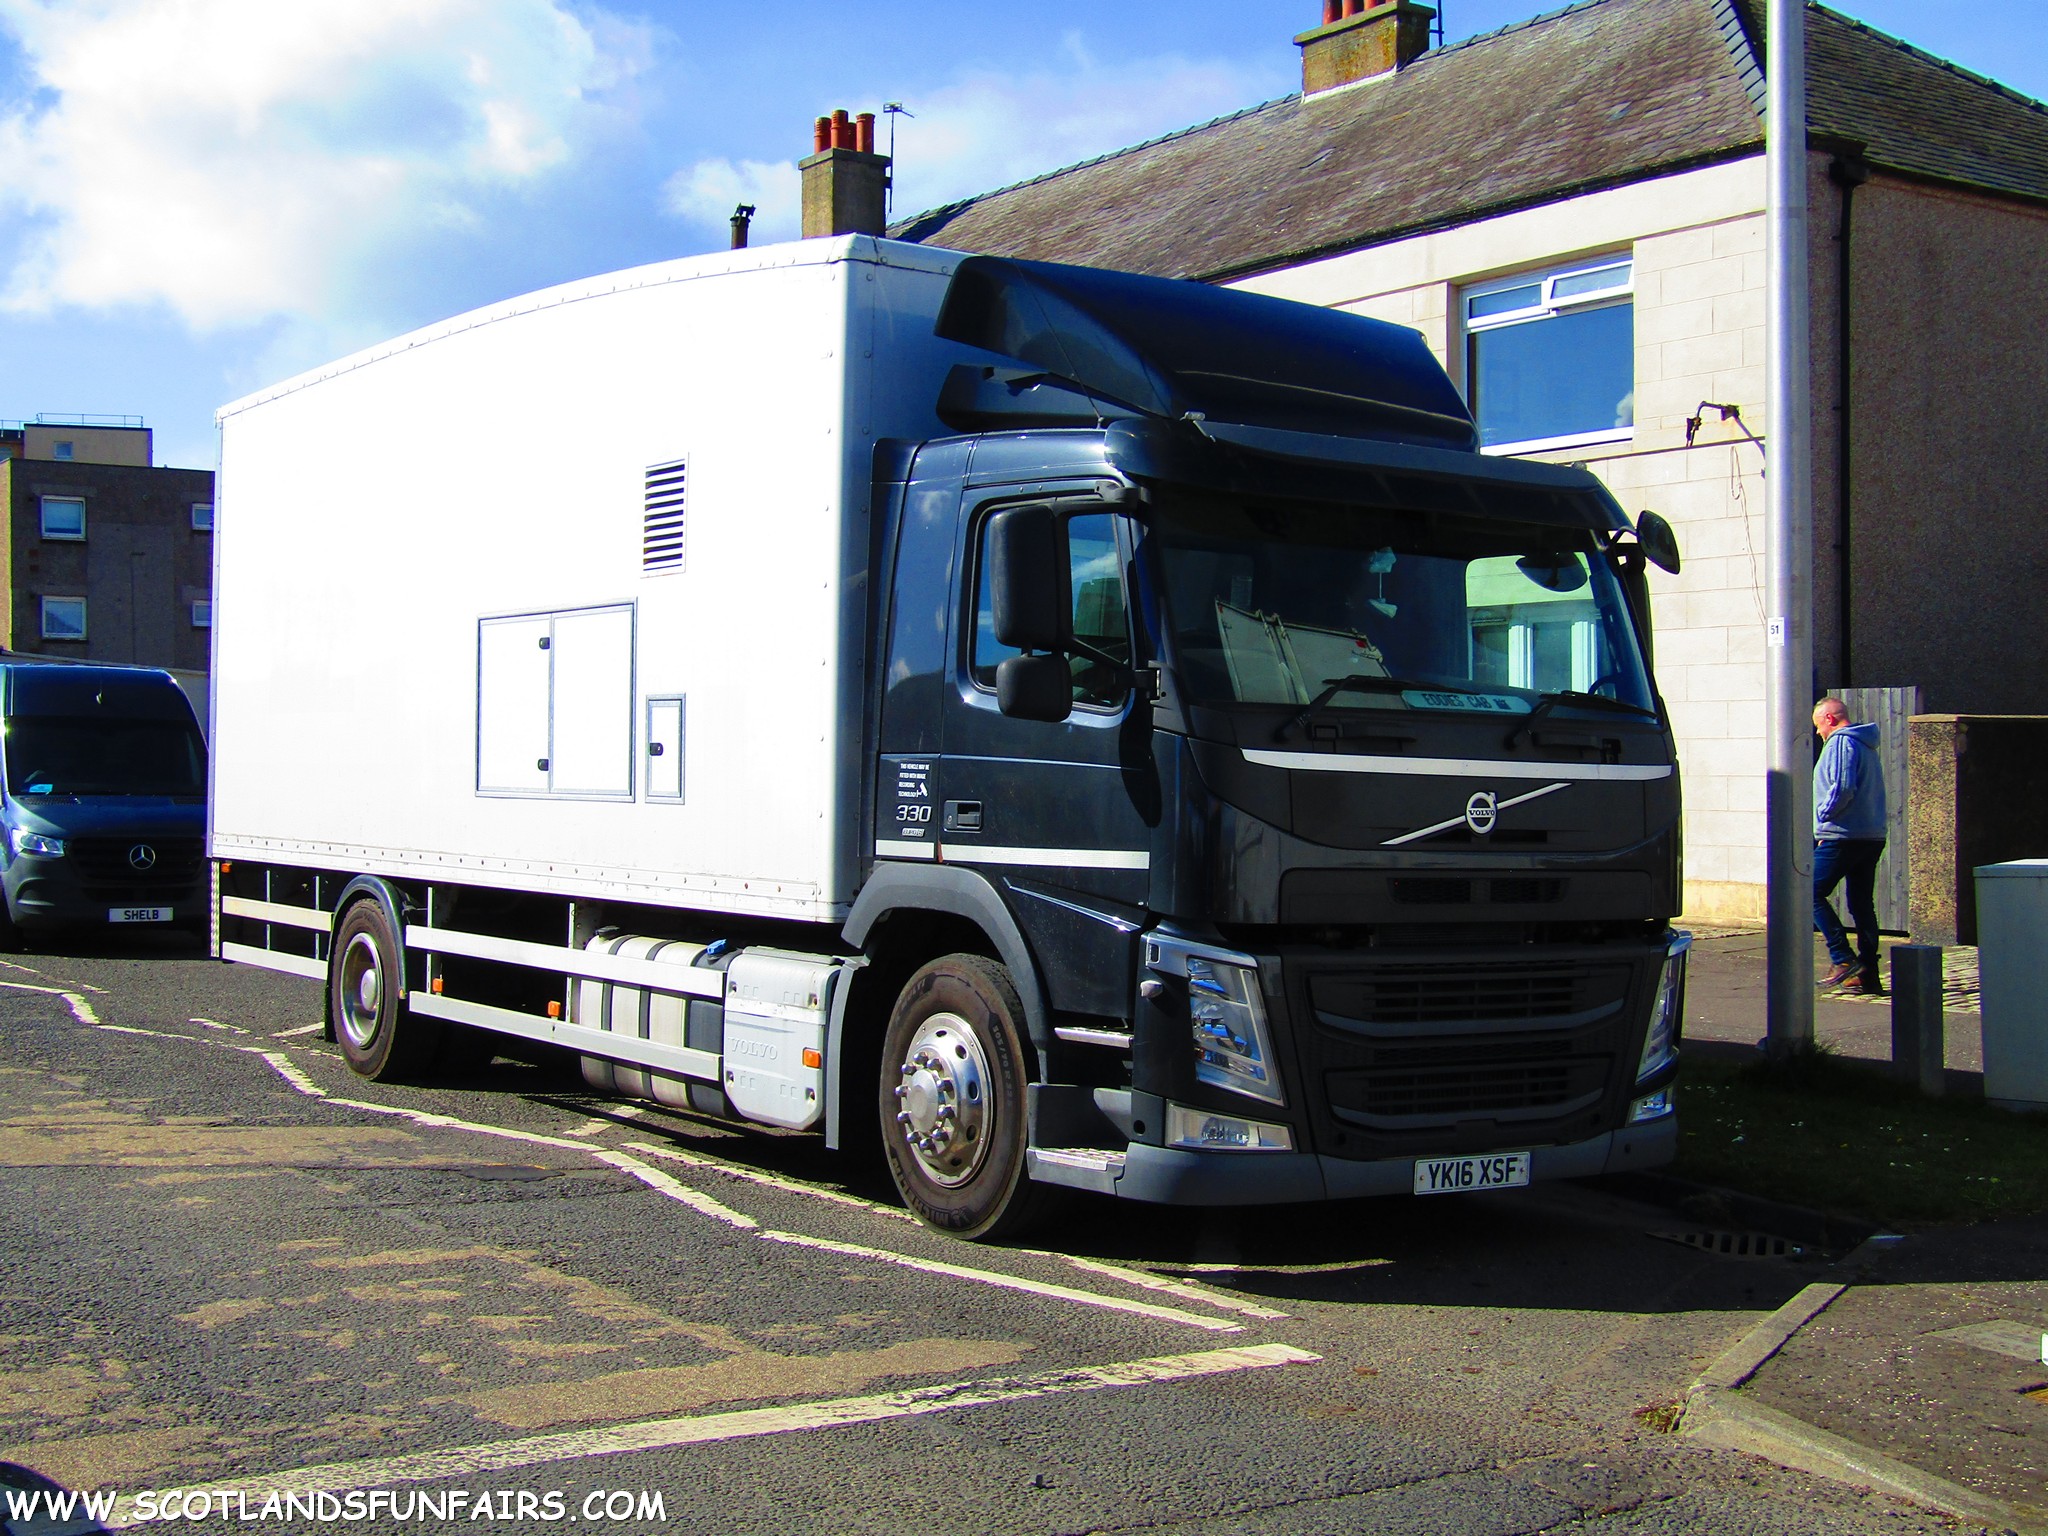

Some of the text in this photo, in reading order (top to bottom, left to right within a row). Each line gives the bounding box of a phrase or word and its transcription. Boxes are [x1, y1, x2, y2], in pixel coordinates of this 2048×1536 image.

[1770, 624, 1779, 635] 51
[1421, 693, 1493, 709] EDDIES CAB
[895, 804, 932, 822] 330
[728, 1036, 778, 1060] VOLVO
[1428, 1156, 1518, 1189] YK16 XSF
